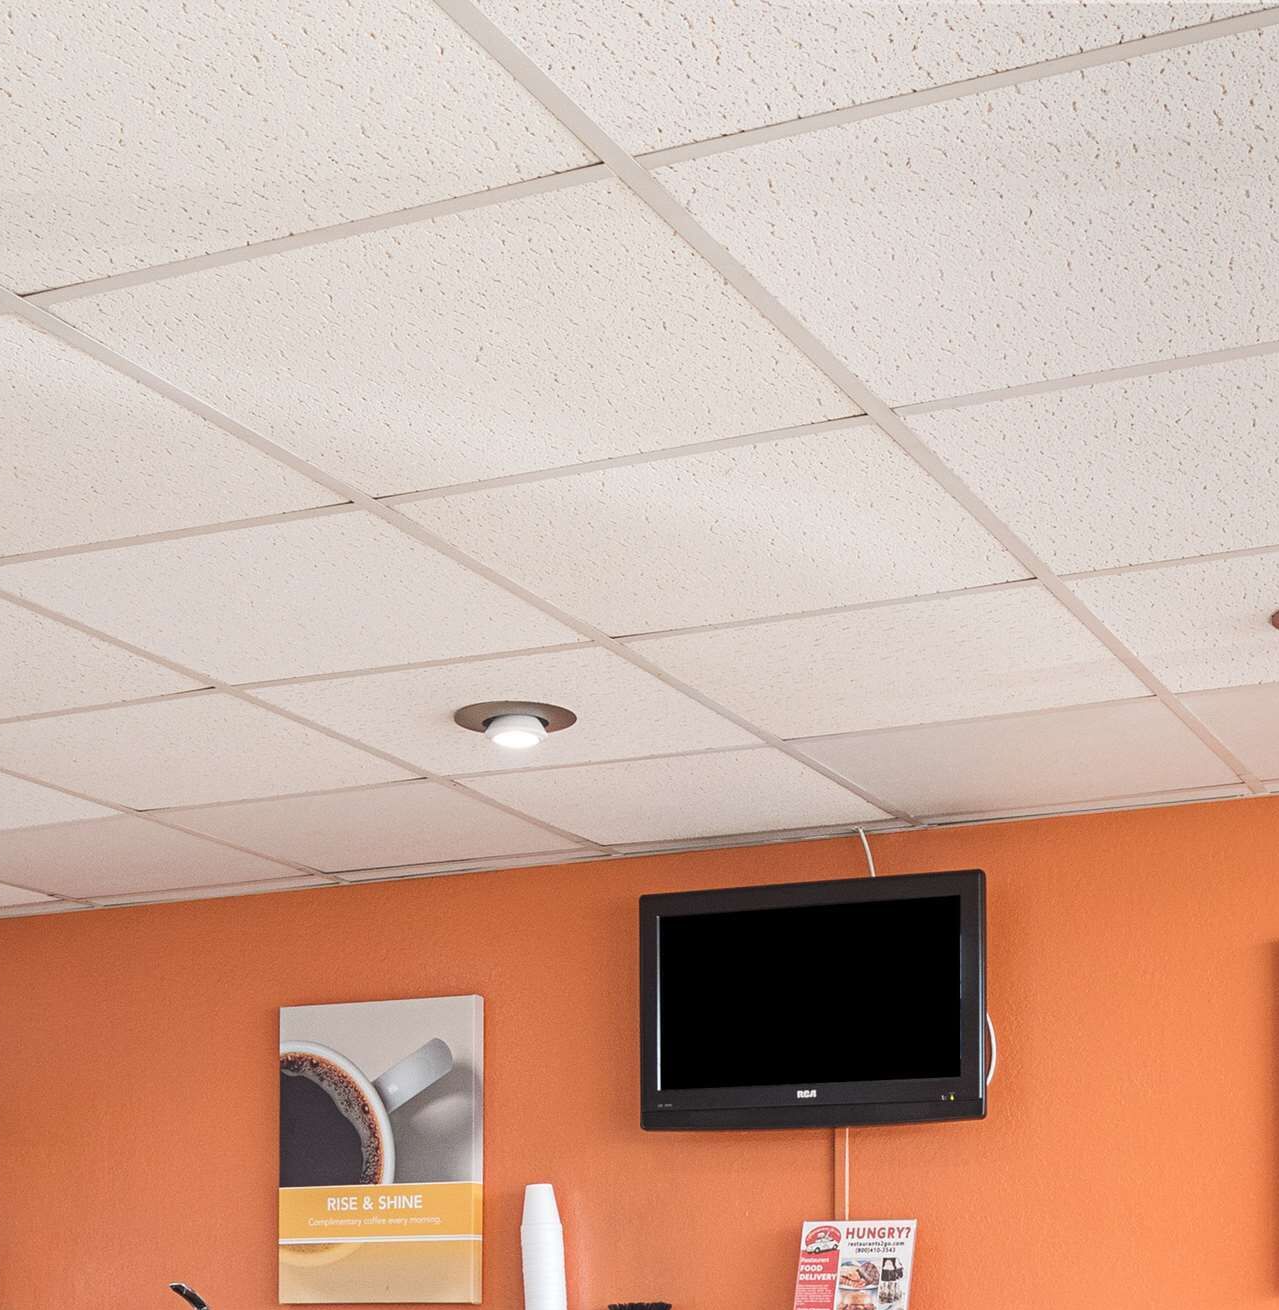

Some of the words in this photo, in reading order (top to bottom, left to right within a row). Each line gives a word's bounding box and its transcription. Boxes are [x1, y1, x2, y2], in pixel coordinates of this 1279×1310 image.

[796, 1090, 816, 1099] RCA
[327, 1197, 357, 1211] RISE
[362, 1197, 374, 1210] &
[378, 1195, 422, 1209] SHINE
[308, 1217, 362, 1227] Complimentary
[363, 1217, 386, 1225] coffee
[387, 1218, 408, 1226] every
[846, 1227, 911, 1239] HUNGRY?
[799, 1273, 837, 1281] DELIVERY
